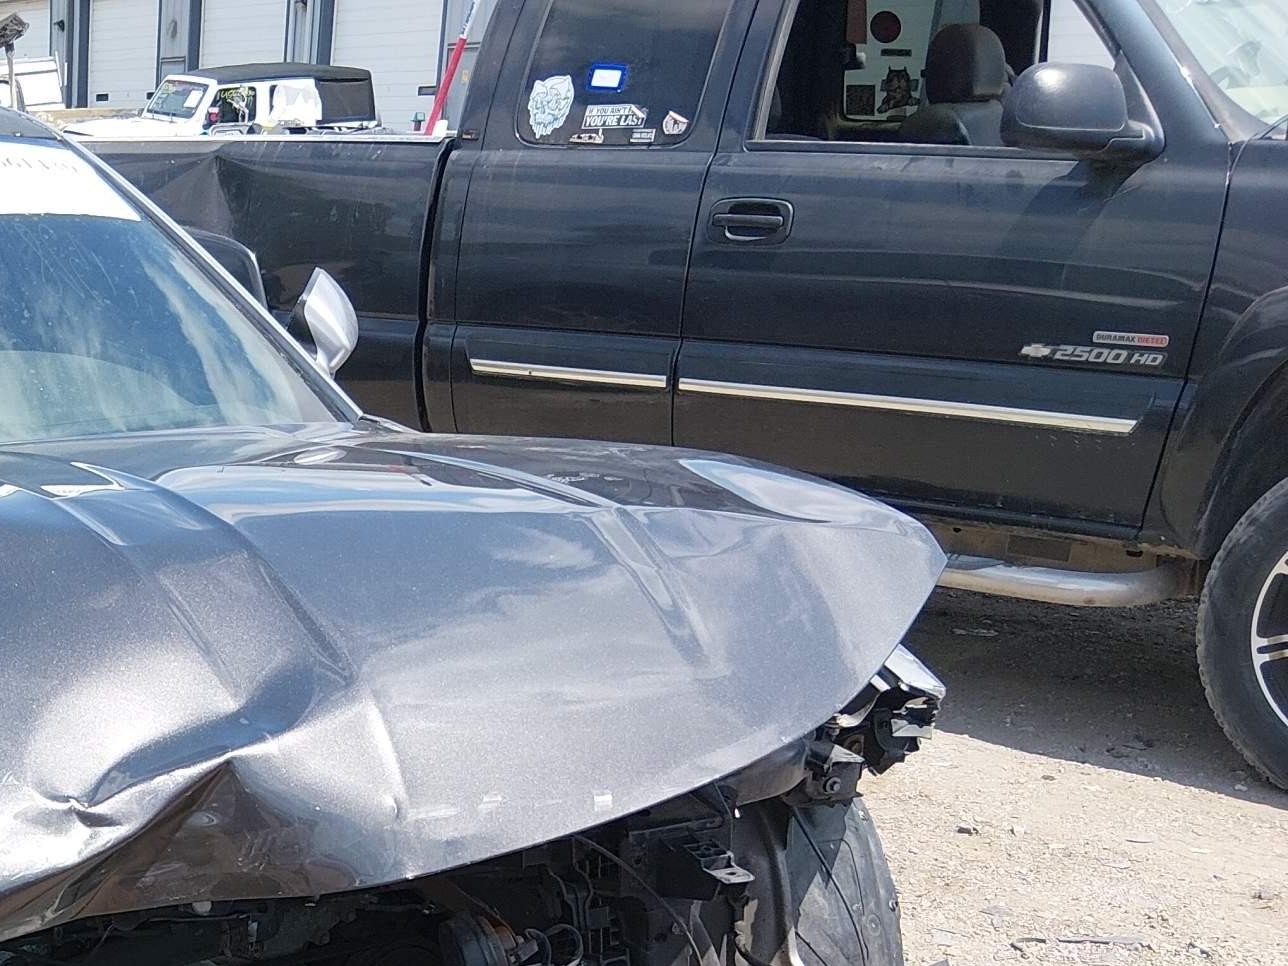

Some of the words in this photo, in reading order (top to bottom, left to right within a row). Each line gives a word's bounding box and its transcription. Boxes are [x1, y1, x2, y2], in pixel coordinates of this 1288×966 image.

[585, 116, 619, 126] YOU'RE
[1095, 333, 1136, 343] DURAMAX
[1053, 344, 1128, 364] 2500
[1130, 353, 1163, 365] HD
